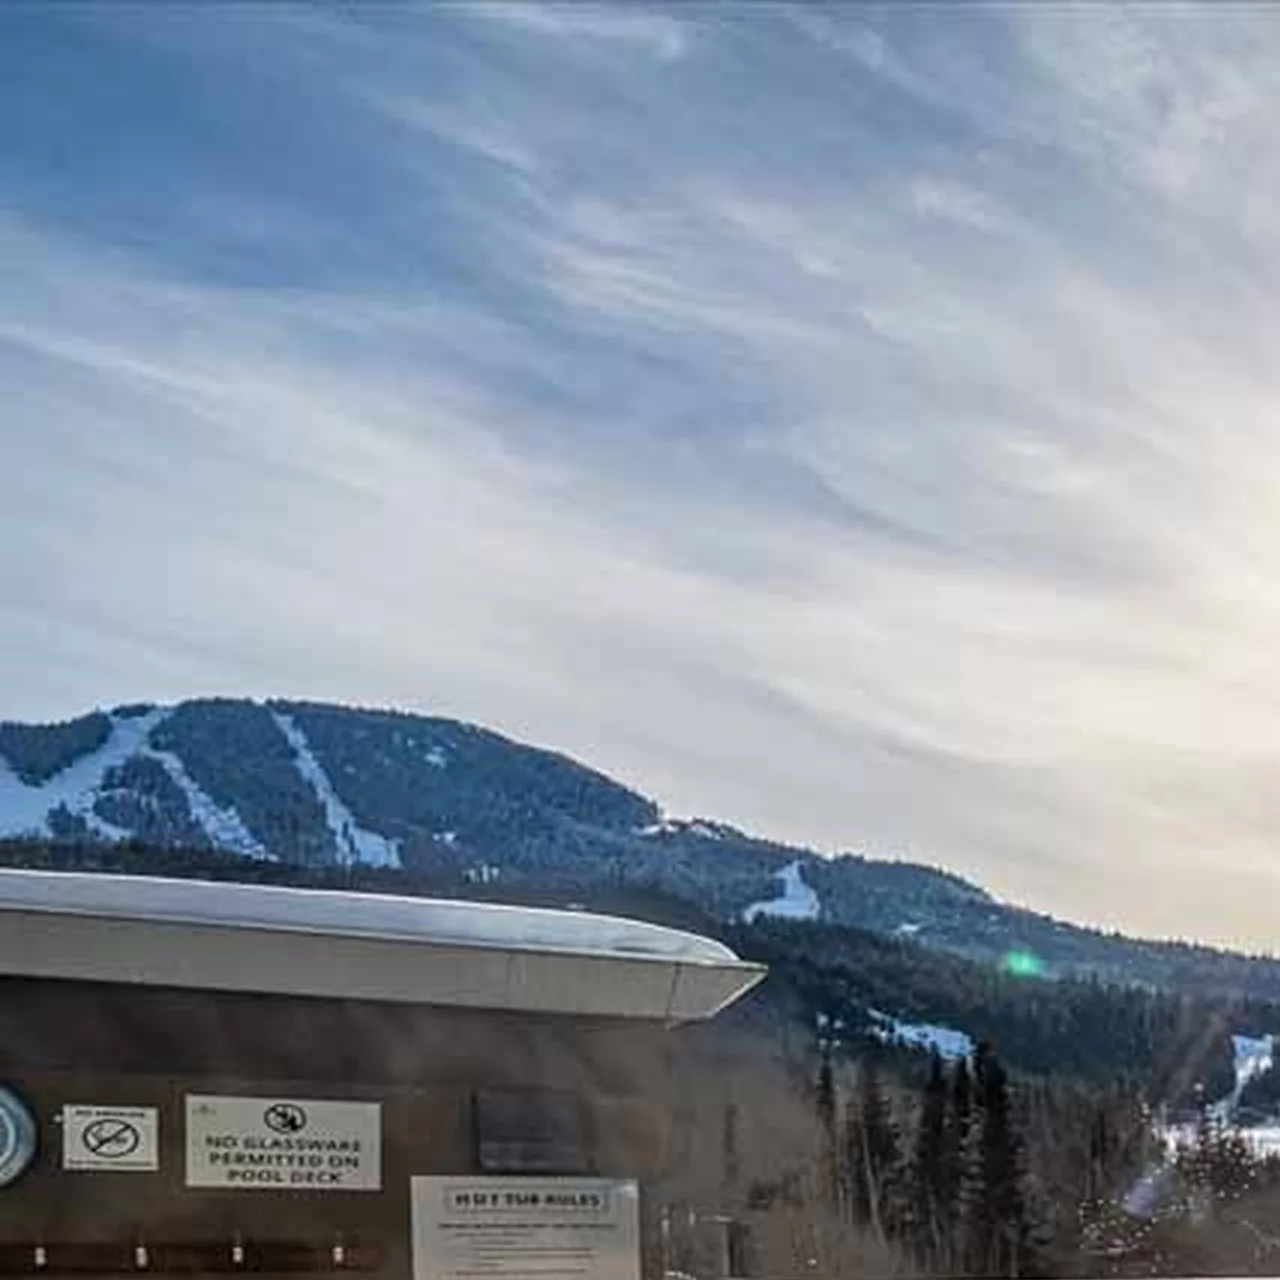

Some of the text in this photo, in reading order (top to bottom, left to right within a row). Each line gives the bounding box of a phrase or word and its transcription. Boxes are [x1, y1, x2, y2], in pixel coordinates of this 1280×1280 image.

[205, 1135, 238, 1149] NO
[209, 1151, 359, 1169] PERMITTED ON
[227, 1168, 342, 1184] POOL DECK
